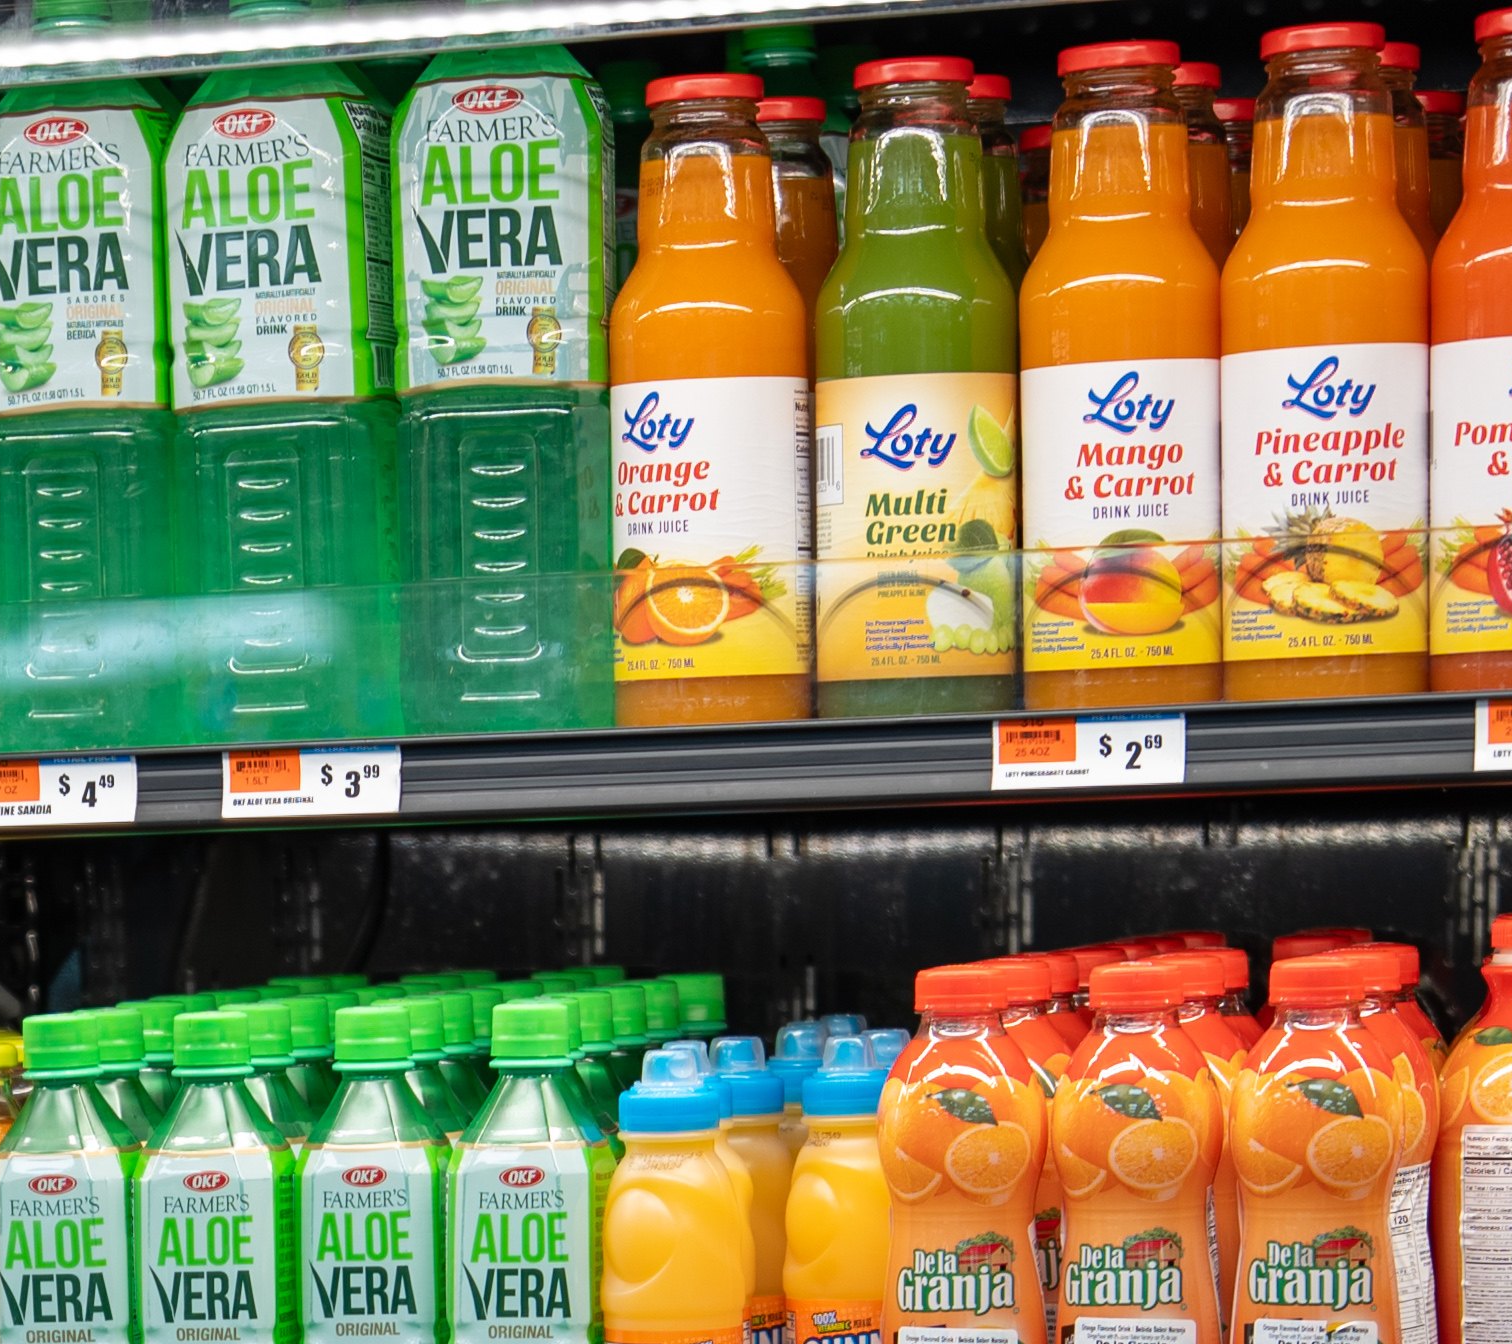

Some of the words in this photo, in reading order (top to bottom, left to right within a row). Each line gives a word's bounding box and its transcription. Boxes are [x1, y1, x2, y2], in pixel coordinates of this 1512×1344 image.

[460, 89, 512, 110] OKF
[426, 114, 556, 141] FARMER'S
[421, 139, 559, 206] ALOE
[417, 205, 562, 275] VERA
[495, 278, 554, 296] ORIGINAL
[495, 304, 526, 317] DRINK
[860, 403, 956, 470] Loty
[1078, 442, 1184, 472] Mango
[865, 489, 946, 517] Multi
[1093, 504, 1131, 520] DRINK
[1137, 503, 1169, 518] JUICE
[865, 518, 956, 548] Green
[15, 805, 52, 816] SANDIA
